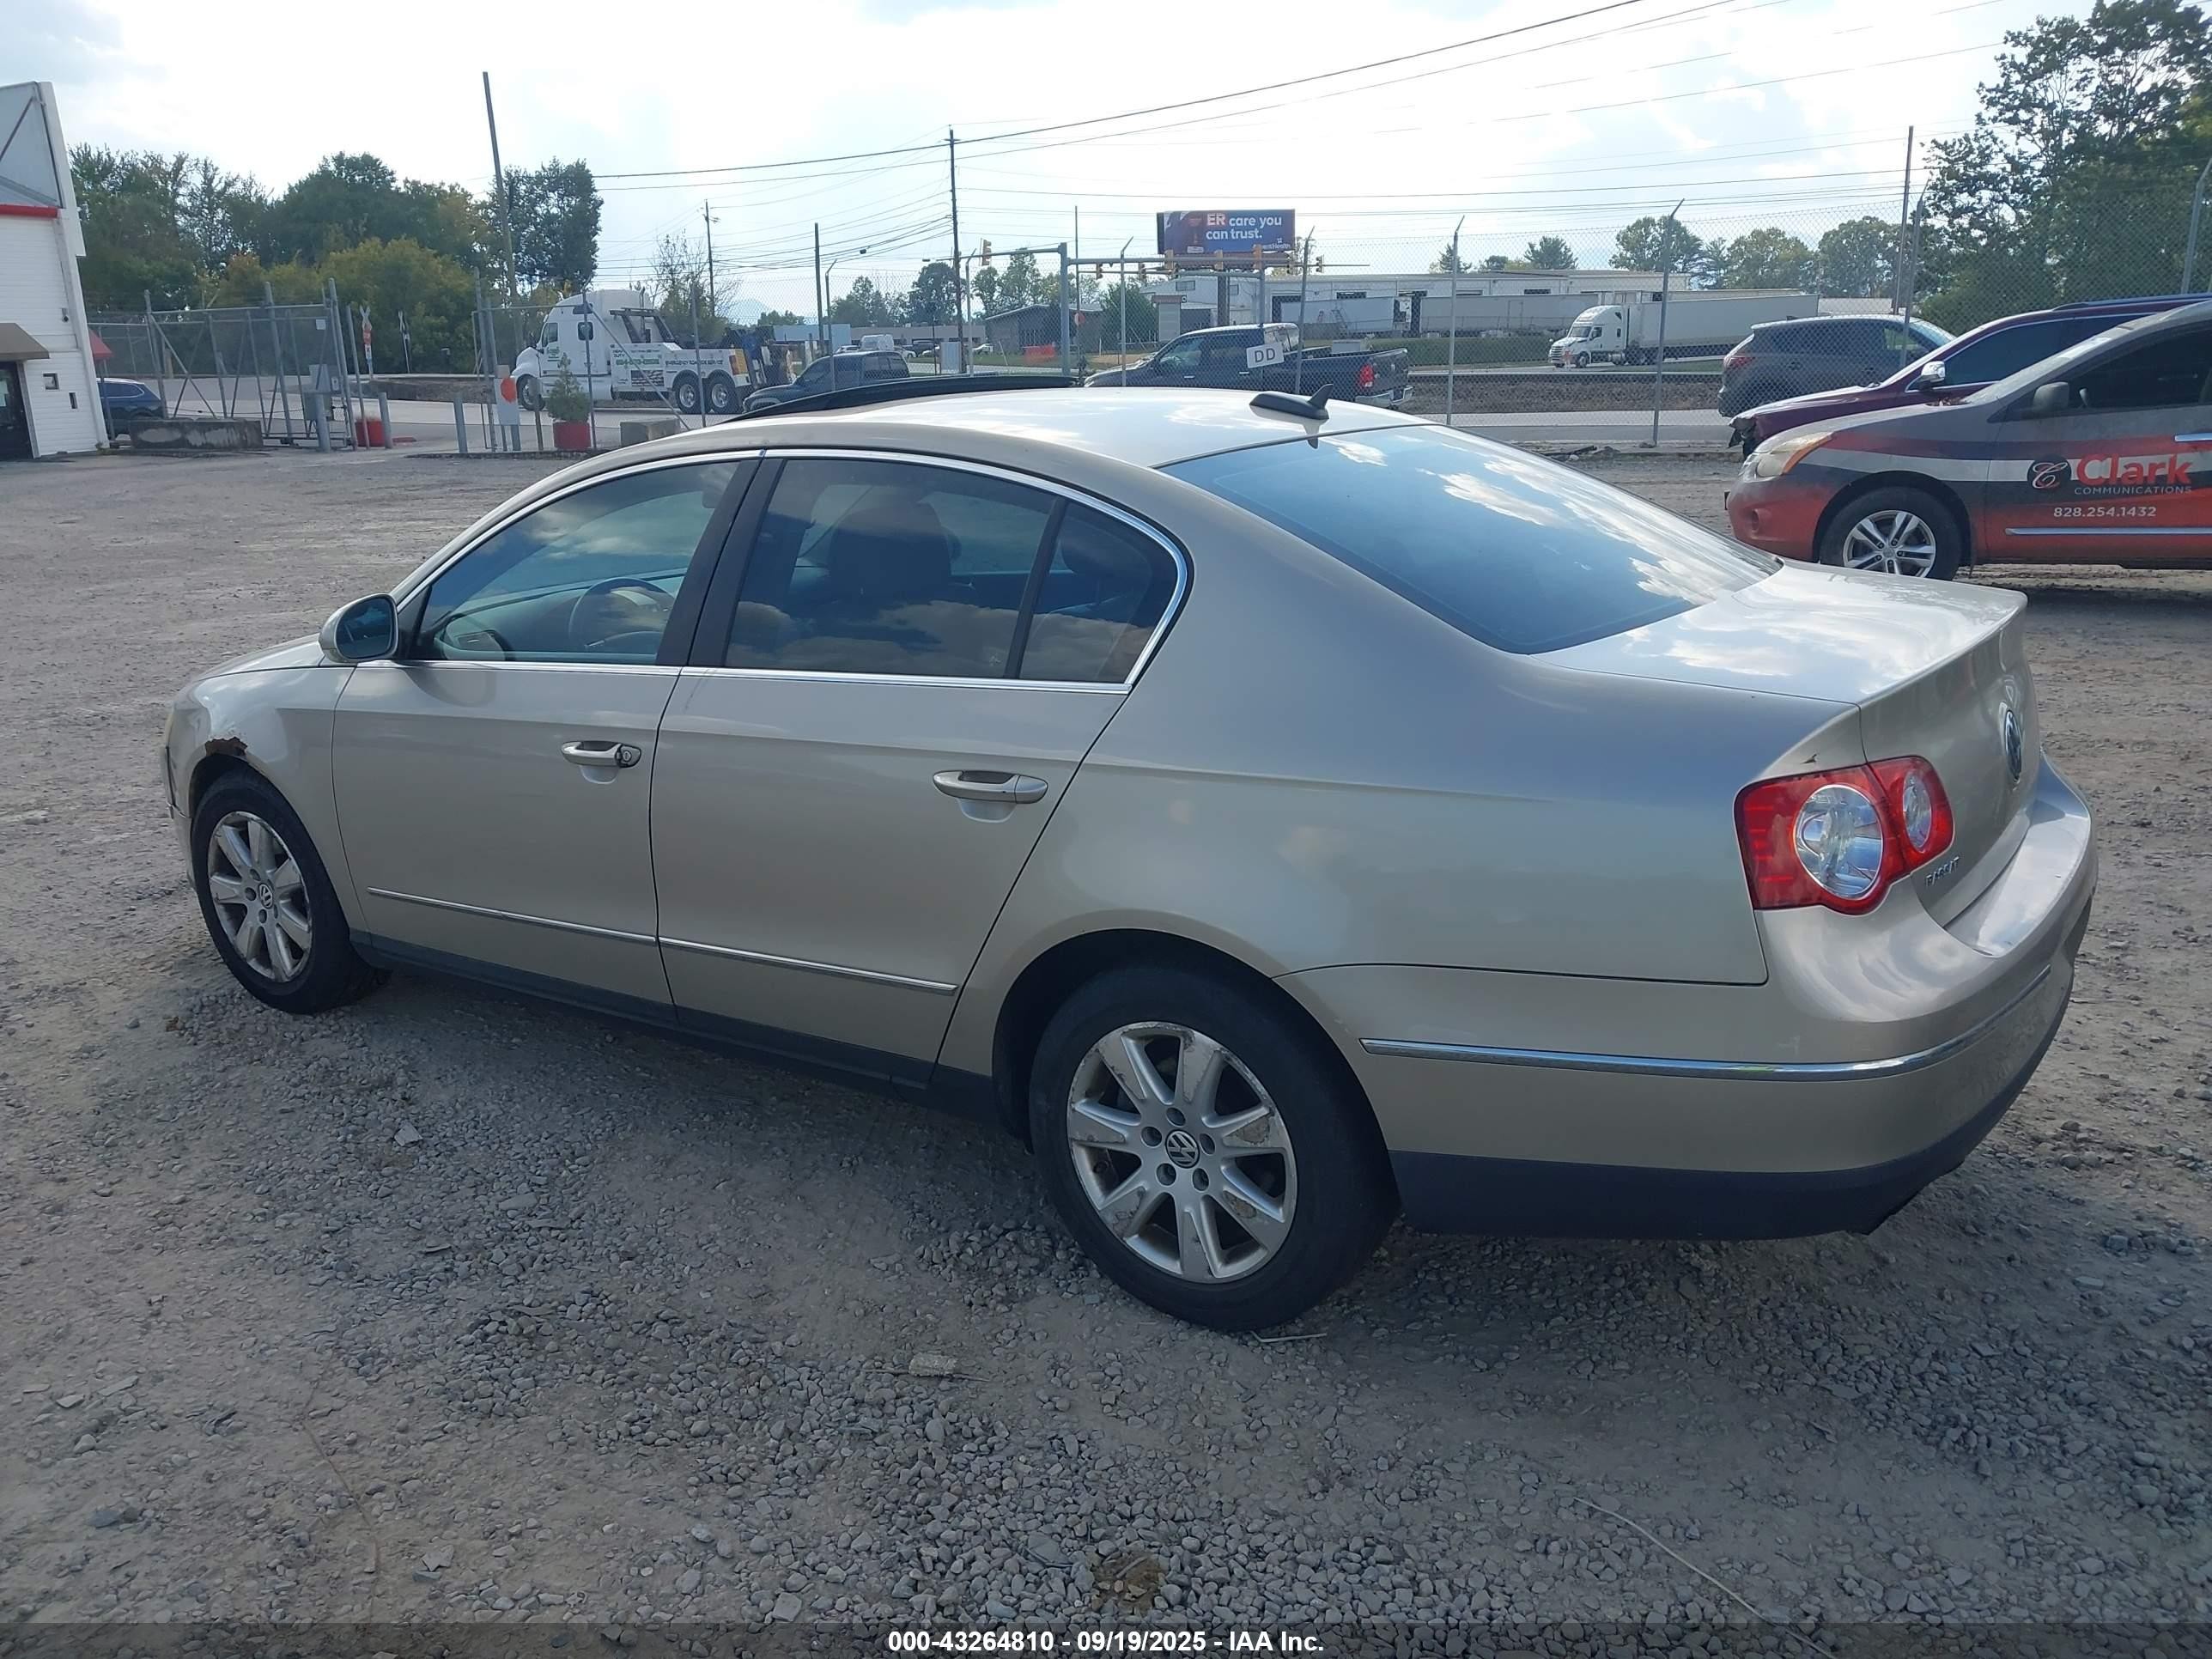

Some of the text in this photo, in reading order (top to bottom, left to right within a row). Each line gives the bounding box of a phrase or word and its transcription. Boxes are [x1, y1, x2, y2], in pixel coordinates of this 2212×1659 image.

[1207, 213, 1282, 228] ER care you
[1206, 228, 1262, 240] can trust.
[1255, 349, 1275, 362] DD
[2076, 453, 2192, 486] Clark
[2075, 486, 2192, 495] COMMUNICATIONS
[2053, 507, 2157, 518] 828.254.1432
